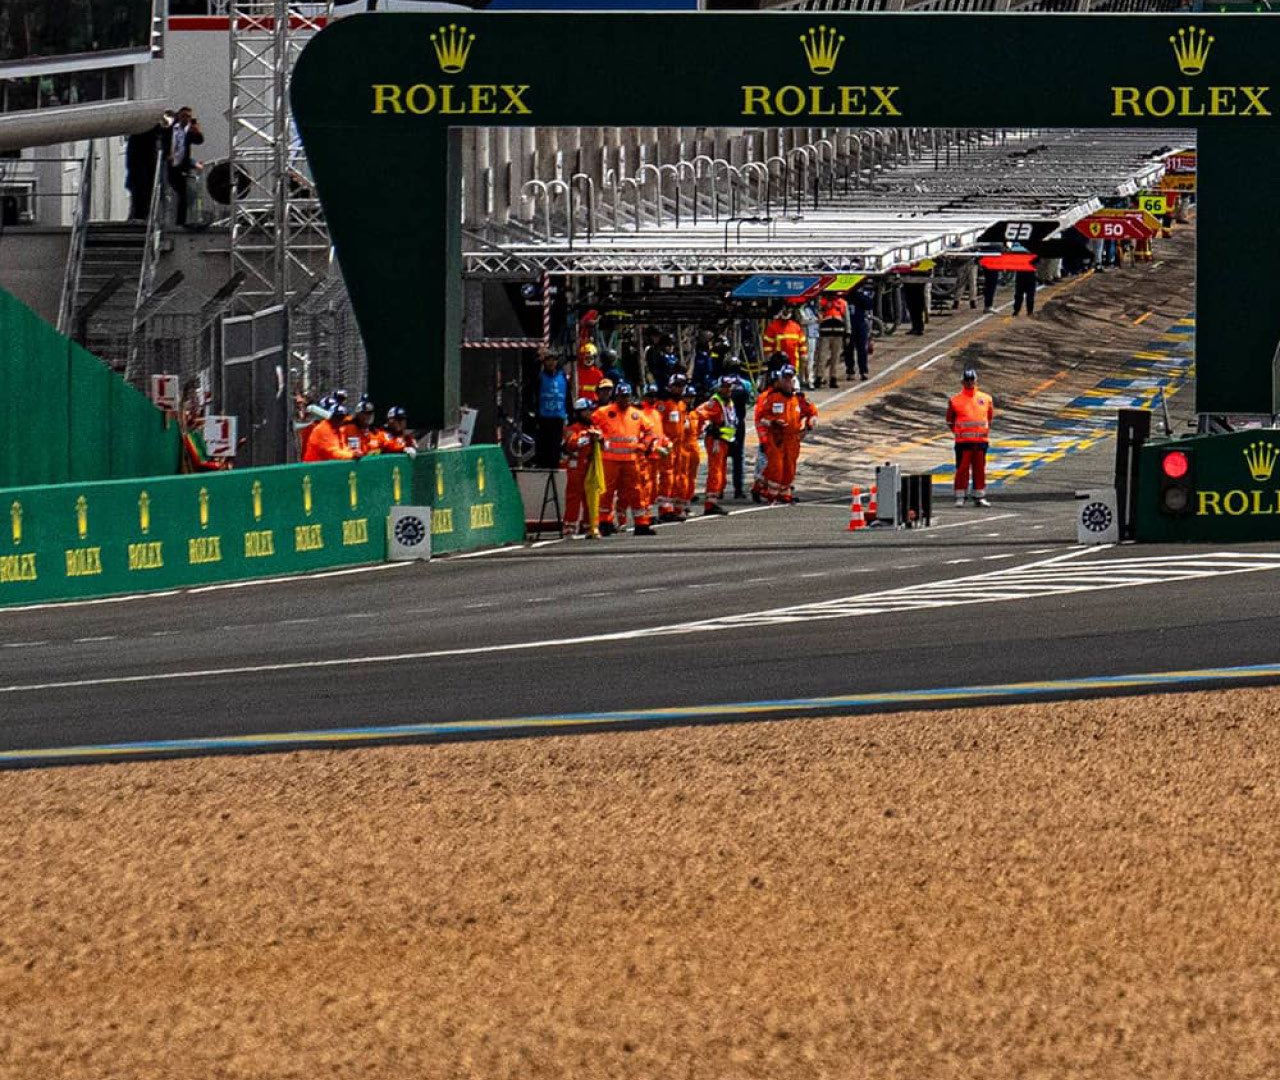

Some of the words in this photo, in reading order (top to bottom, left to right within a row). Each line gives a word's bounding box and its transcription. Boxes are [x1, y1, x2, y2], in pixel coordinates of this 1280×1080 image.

[371, 84, 533, 115] ROLEX
[740, 85, 902, 117] ROLEX
[1110, 86, 1272, 117] ROLEX
[1144, 199, 1162, 211] 66
[1004, 223, 1033, 240] 63
[1104, 223, 1123, 236] 50
